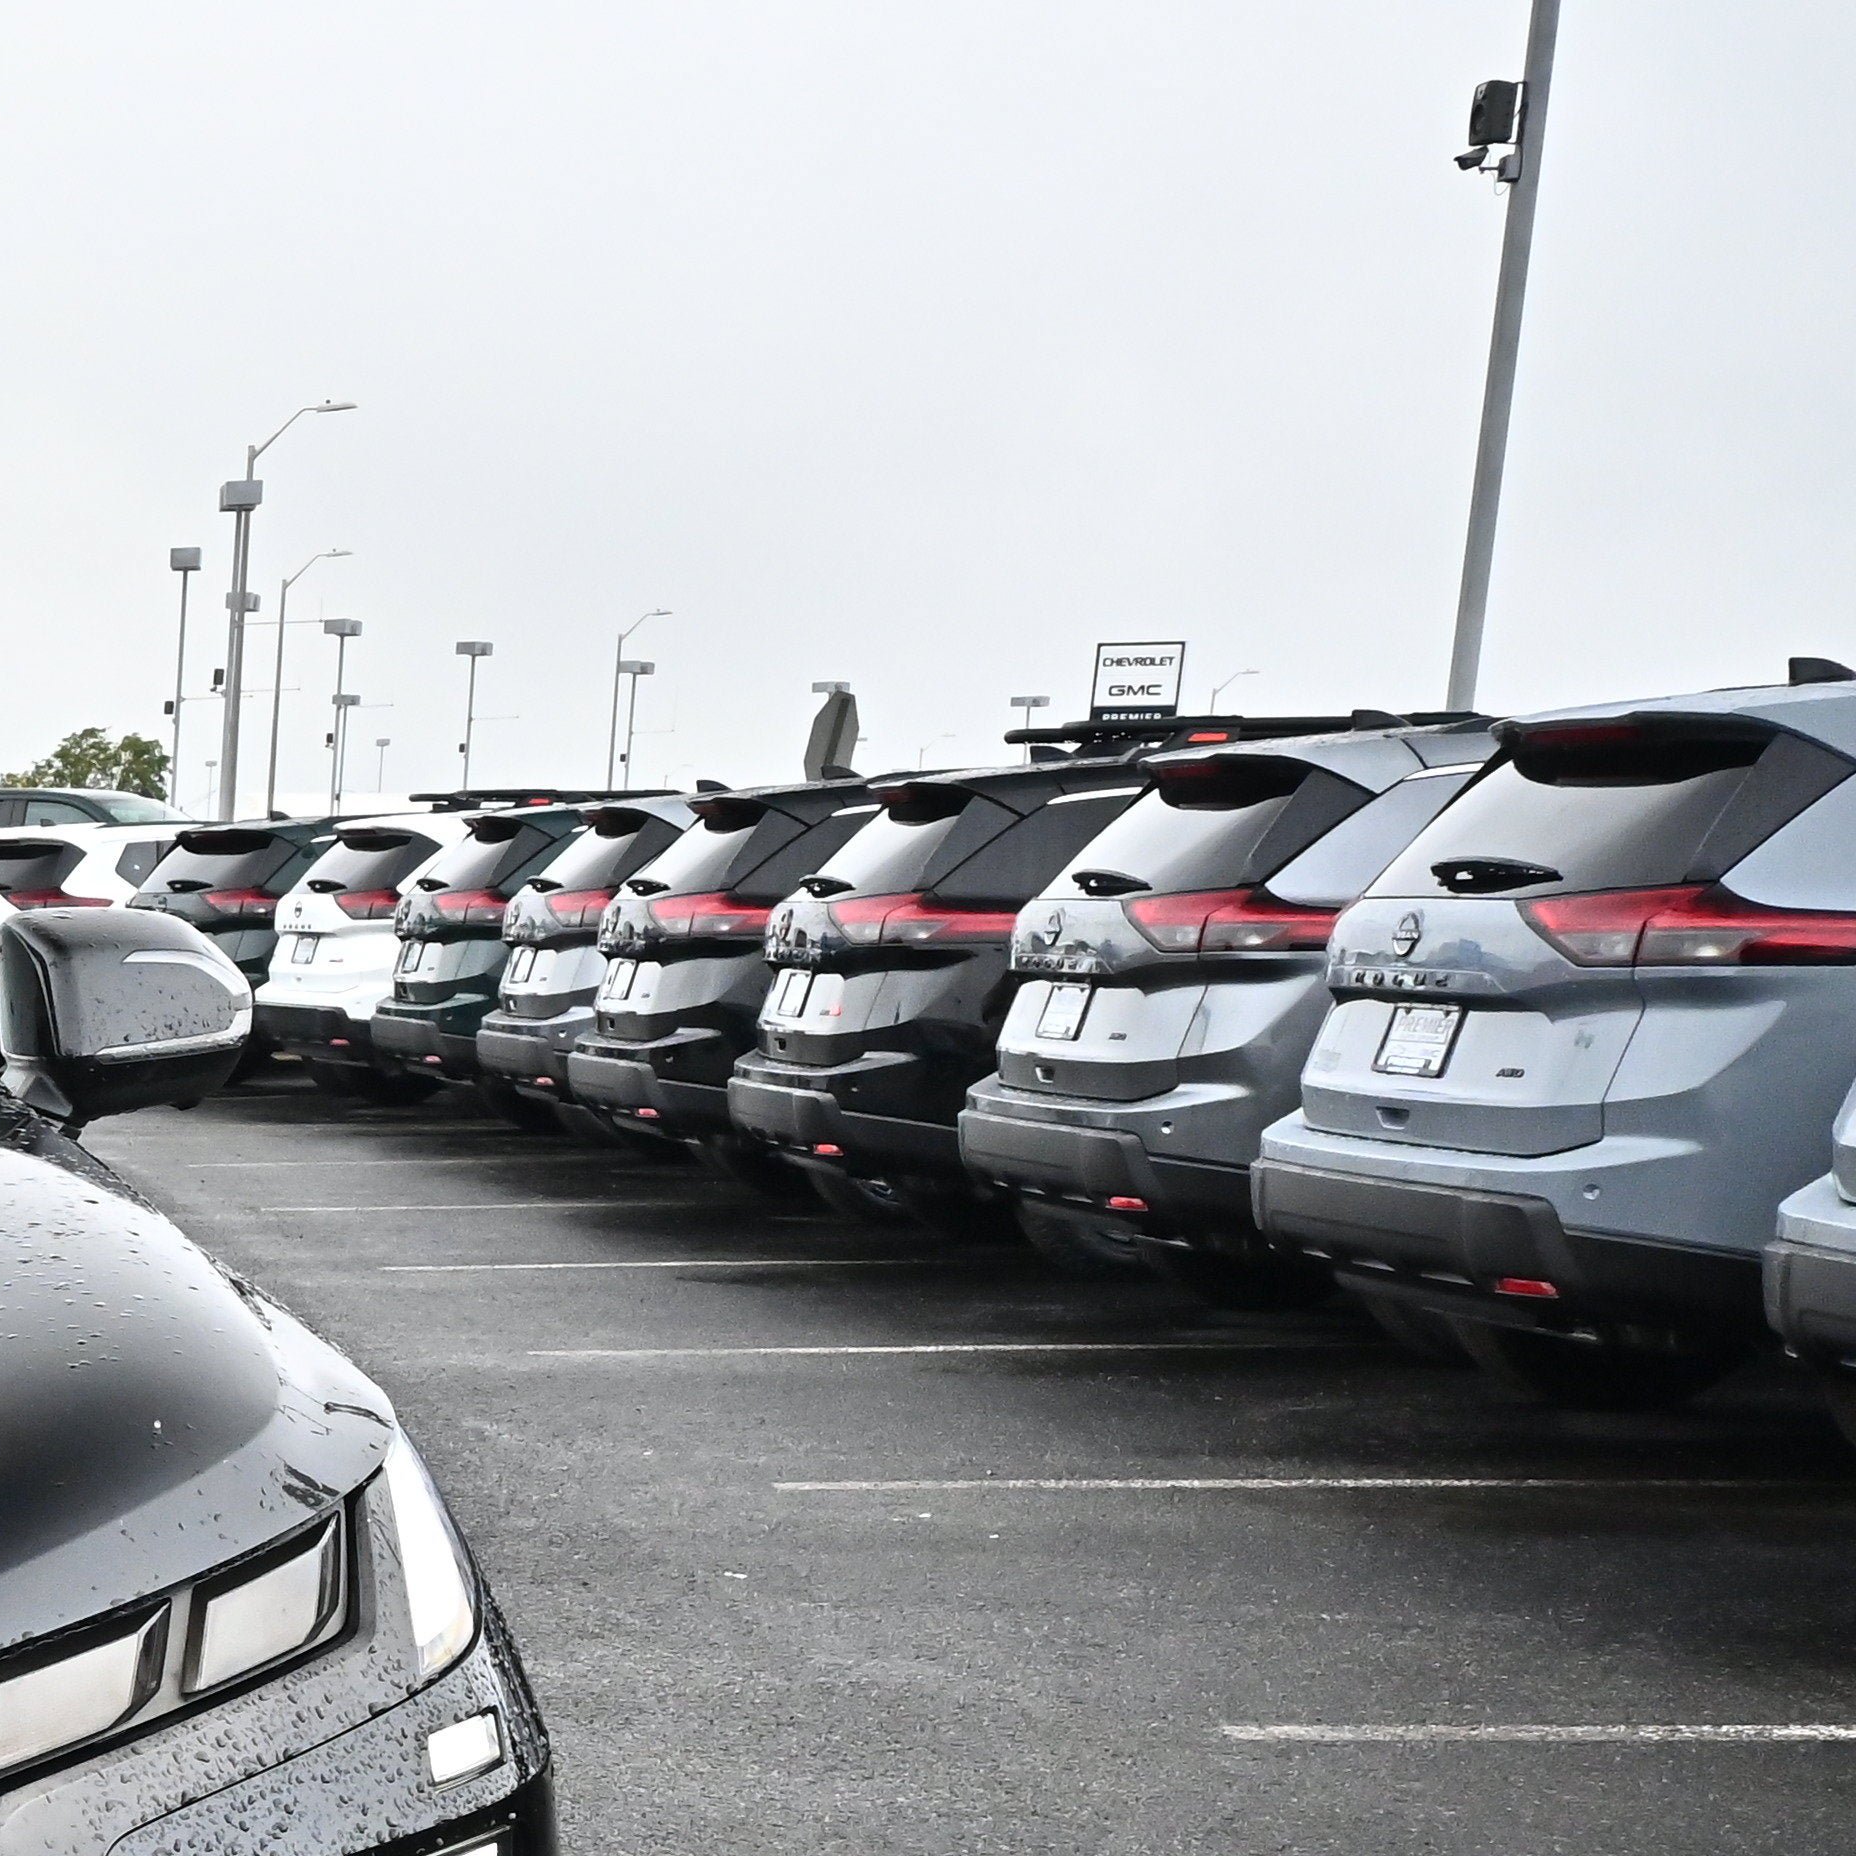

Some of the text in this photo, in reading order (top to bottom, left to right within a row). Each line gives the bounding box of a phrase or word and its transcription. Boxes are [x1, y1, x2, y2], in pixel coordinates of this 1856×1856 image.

[1102, 655, 1176, 668] CHEVROLET
[1108, 684, 1163, 697] GMC
[1101, 712, 1162, 721] PREMIER
